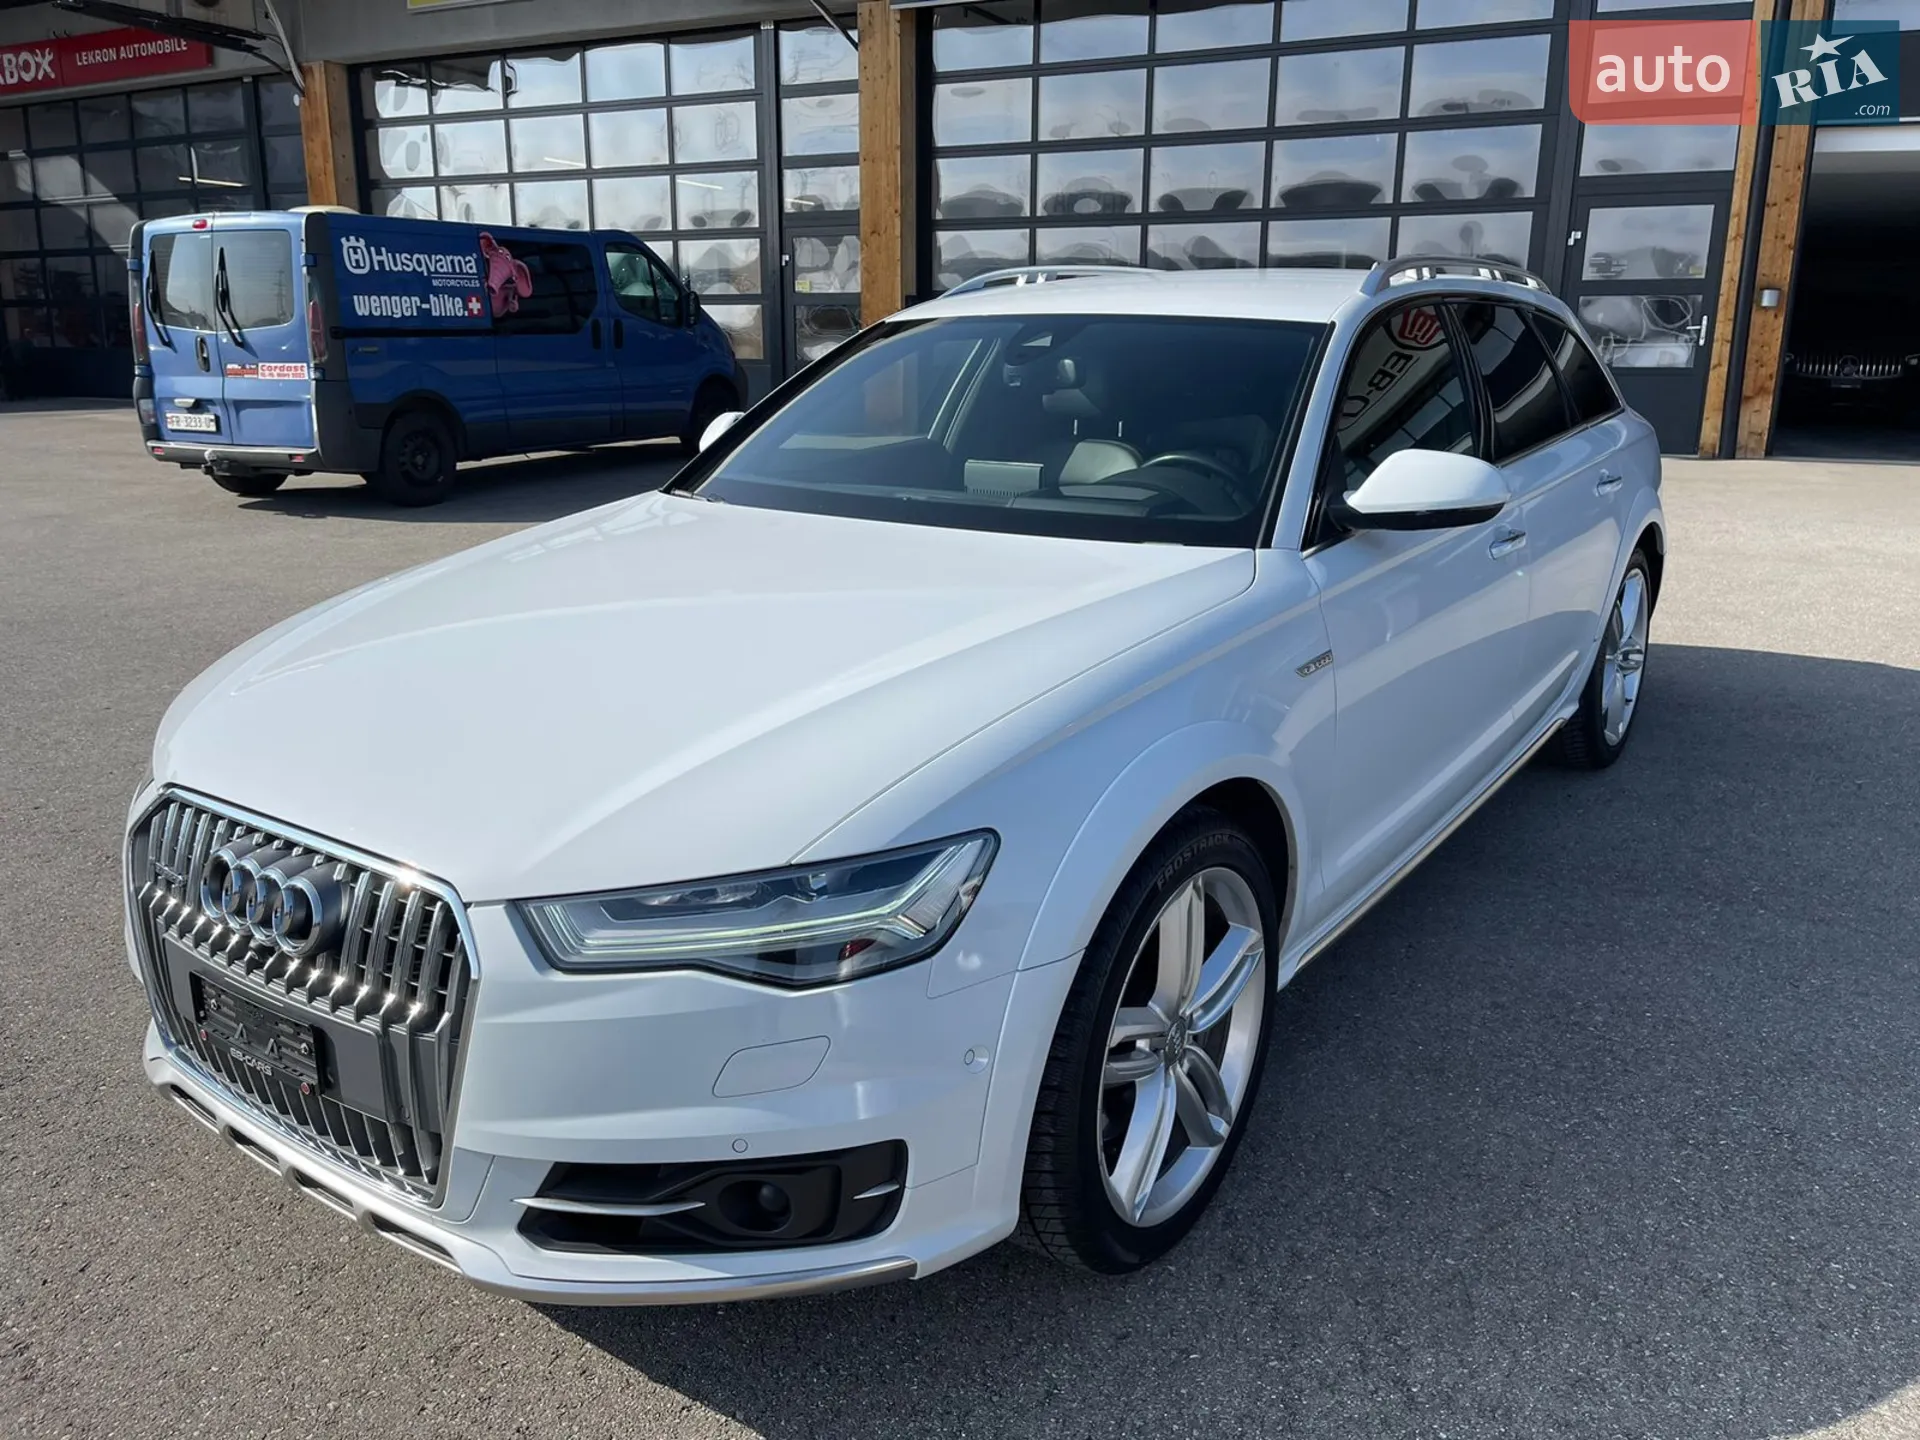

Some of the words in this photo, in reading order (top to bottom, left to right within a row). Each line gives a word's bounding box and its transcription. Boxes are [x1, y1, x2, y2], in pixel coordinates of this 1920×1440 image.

[0, 47, 56, 85] BOX
[76, 47, 117, 66] LEKRON
[119, 38, 188, 60] AUTOMOBILE
[371, 246, 477, 276] Husqvarna
[432, 278, 480, 288] MOTORCYCLES
[1156, 833, 1230, 891] FROSTRACK
